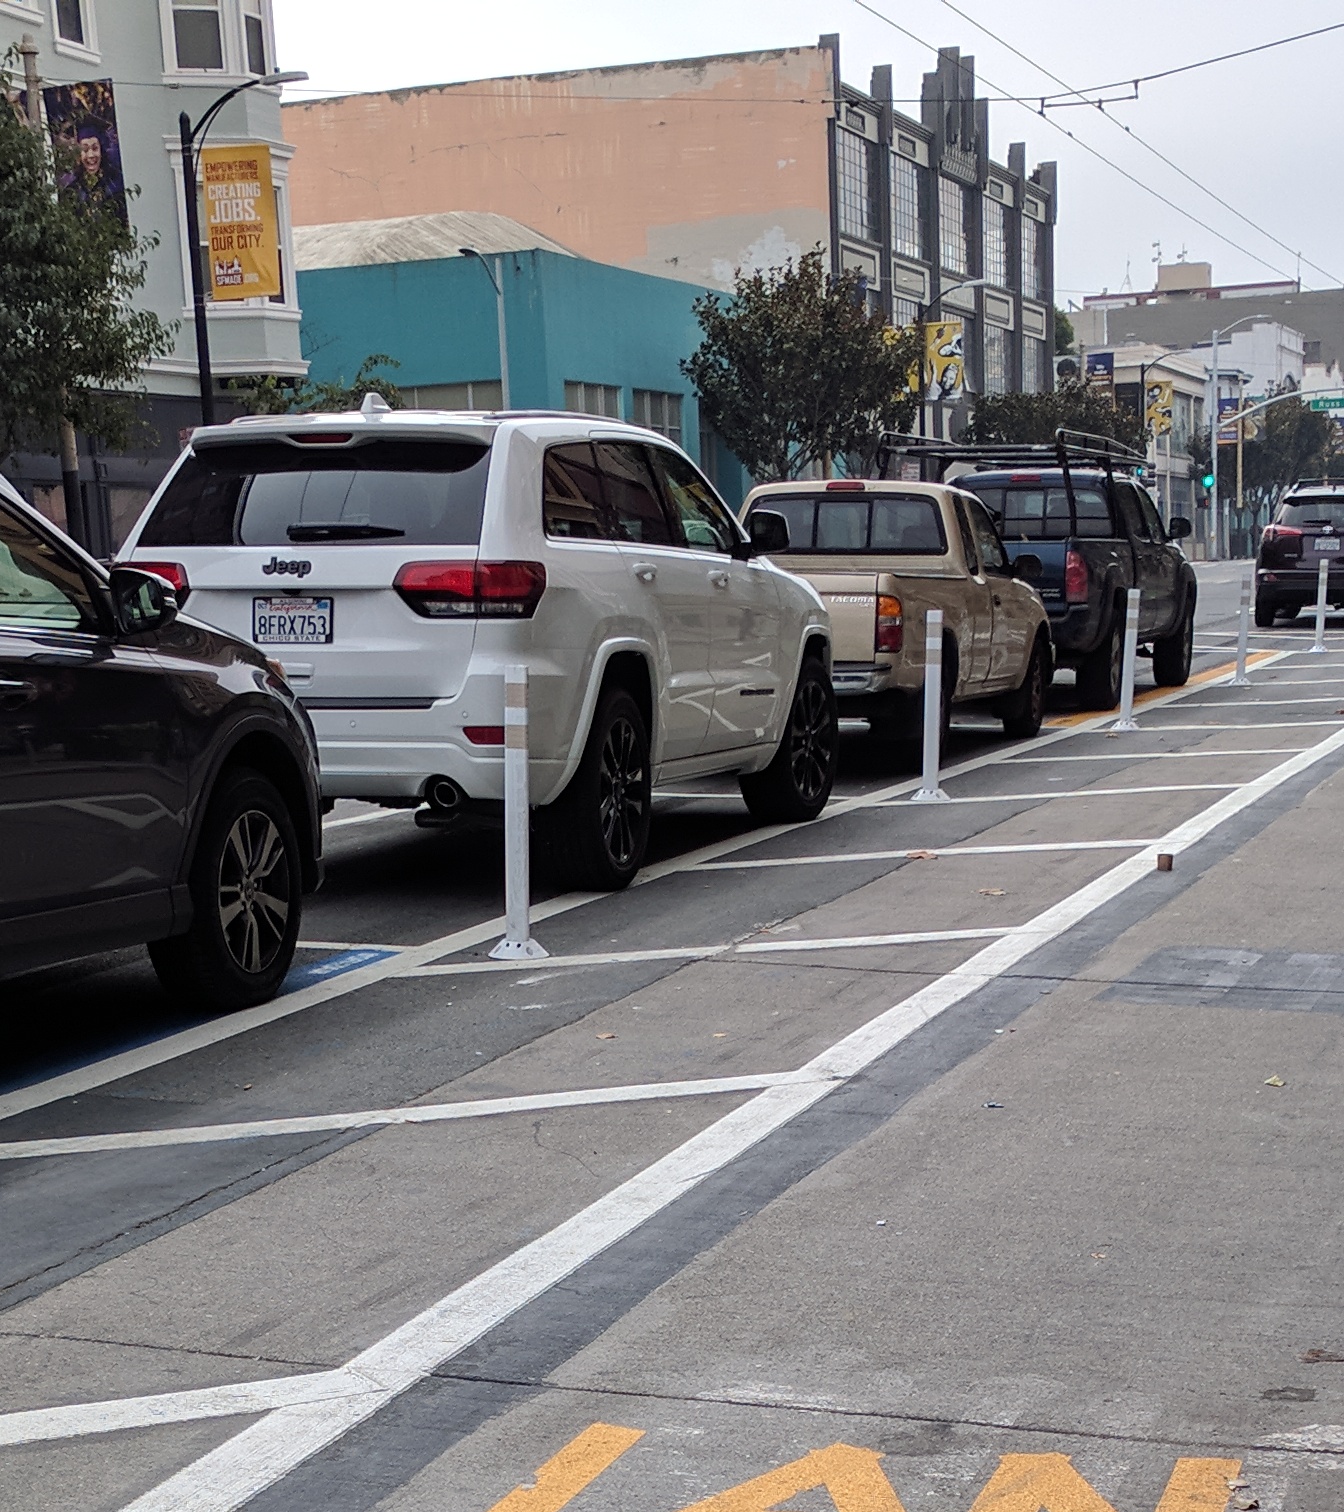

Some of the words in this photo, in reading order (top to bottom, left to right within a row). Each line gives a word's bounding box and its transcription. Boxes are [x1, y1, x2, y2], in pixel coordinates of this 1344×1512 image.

[208, 182, 261, 200] CREATING
[210, 199, 261, 224] JOBS.
[210, 222, 264, 236] TRANSFORMING
[212, 235, 234, 252] OUR
[237, 233, 264, 249] CITY.
[262, 556, 312, 578] Jeep
[830, 595, 874, 603] TACOMA
[258, 615, 326, 635] 8FRX753
